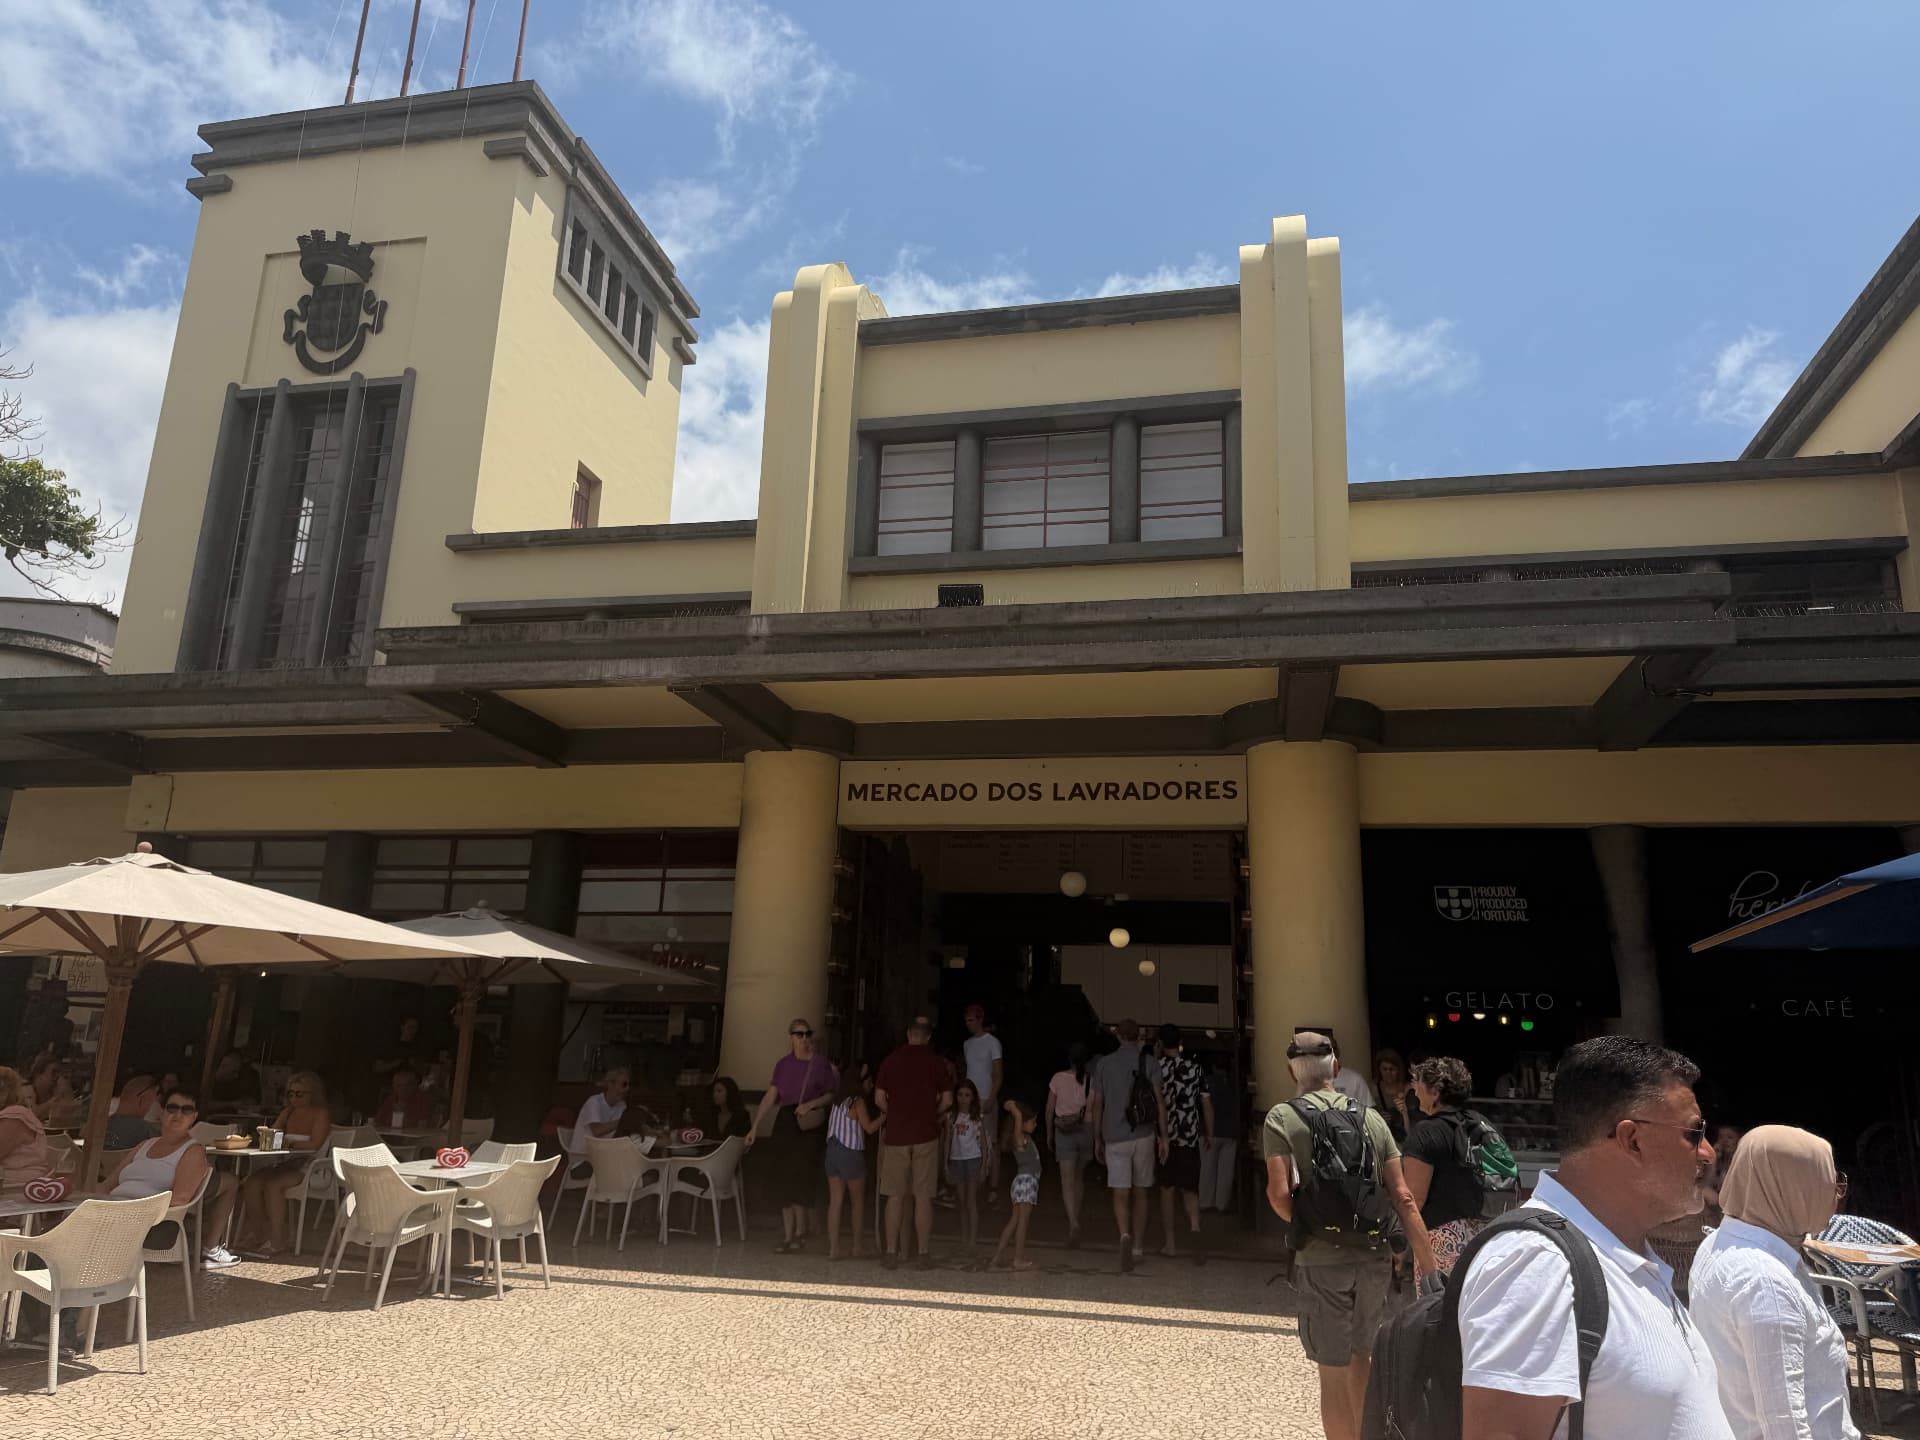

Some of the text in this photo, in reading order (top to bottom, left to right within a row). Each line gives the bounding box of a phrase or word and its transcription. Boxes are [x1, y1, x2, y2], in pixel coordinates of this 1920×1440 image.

[847, 780, 1238, 802] MERCADO DOS LAVRADORES
[1473, 886, 1517, 897] PROUDLY
[1475, 898, 1528, 909] PRODUCED
[1477, 910, 1529, 921] PORTUGAL
[1445, 991, 1554, 1010] GELATO
[1781, 996, 1855, 1018] CAFÉ
